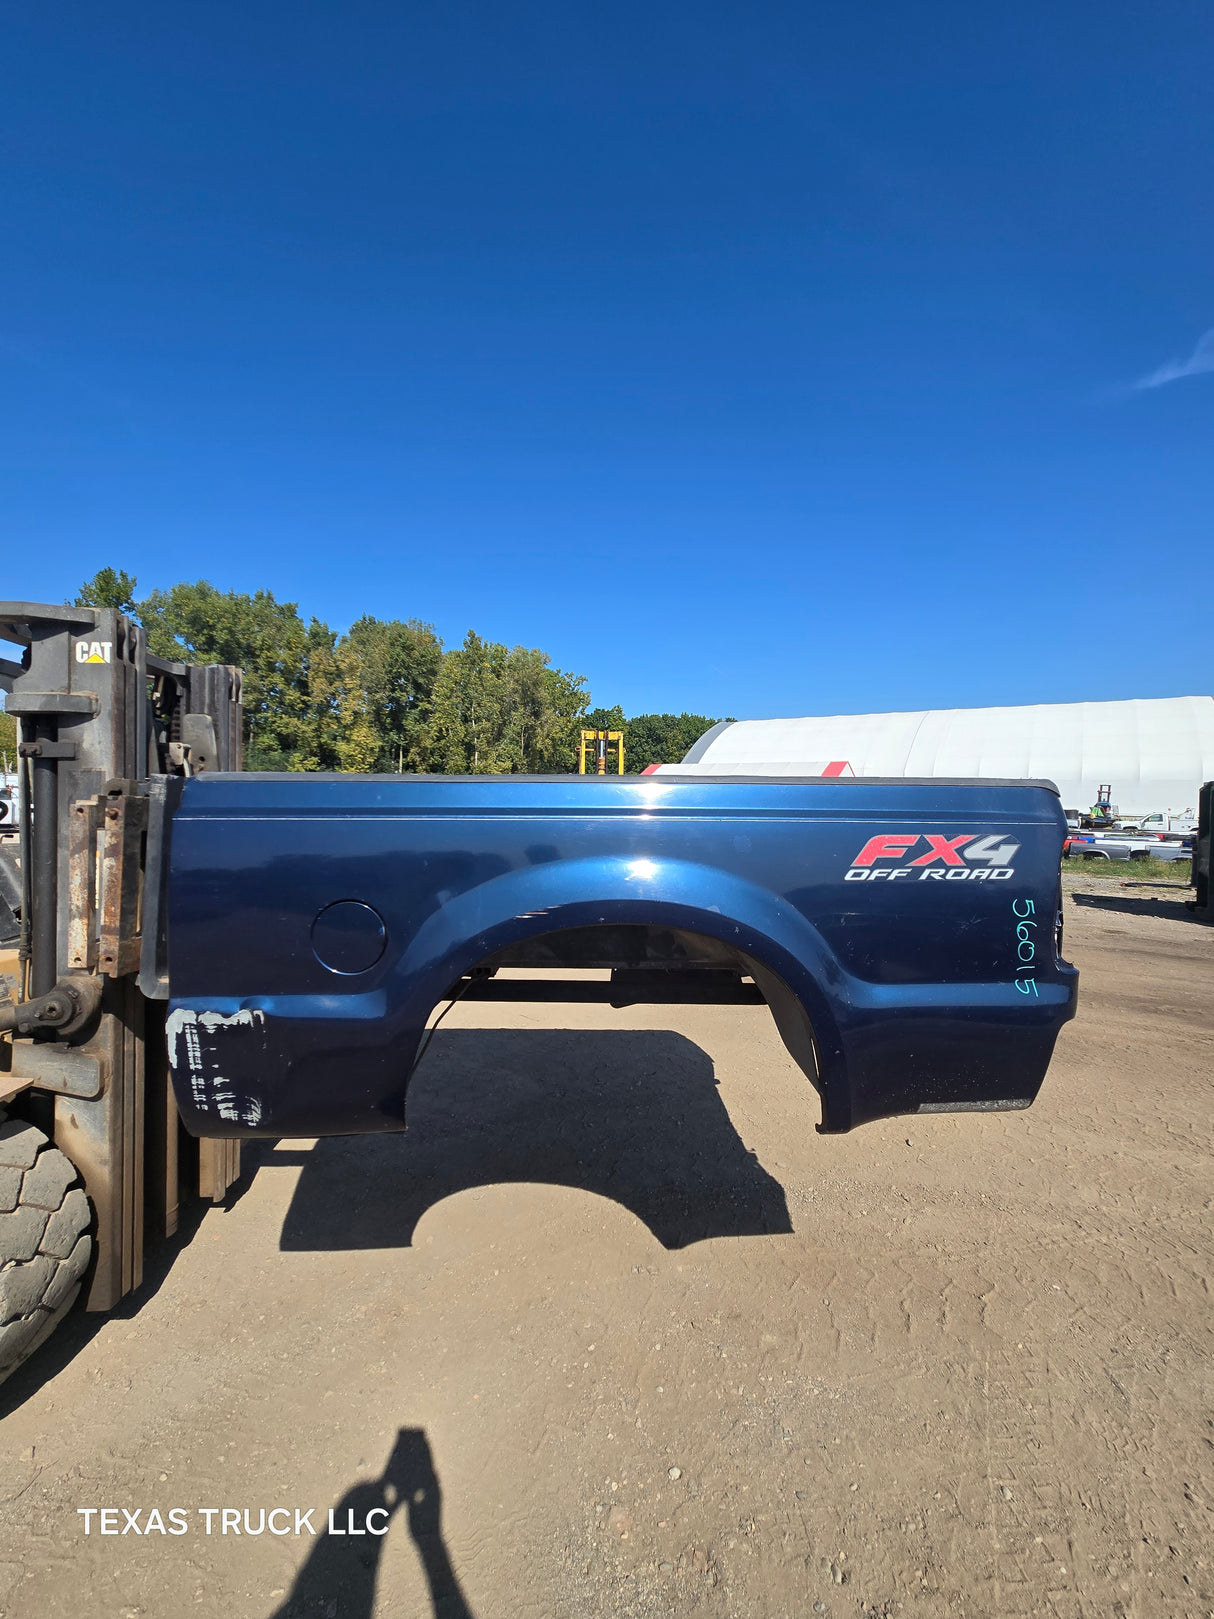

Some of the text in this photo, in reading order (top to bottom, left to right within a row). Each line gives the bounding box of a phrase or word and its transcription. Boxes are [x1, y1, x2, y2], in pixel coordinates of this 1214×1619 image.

[75, 641, 112, 663] CAT
[850, 834, 1021, 867] FX4
[844, 868, 1015, 881] OFF ROAD
[1012, 898, 1039, 997] 56015
